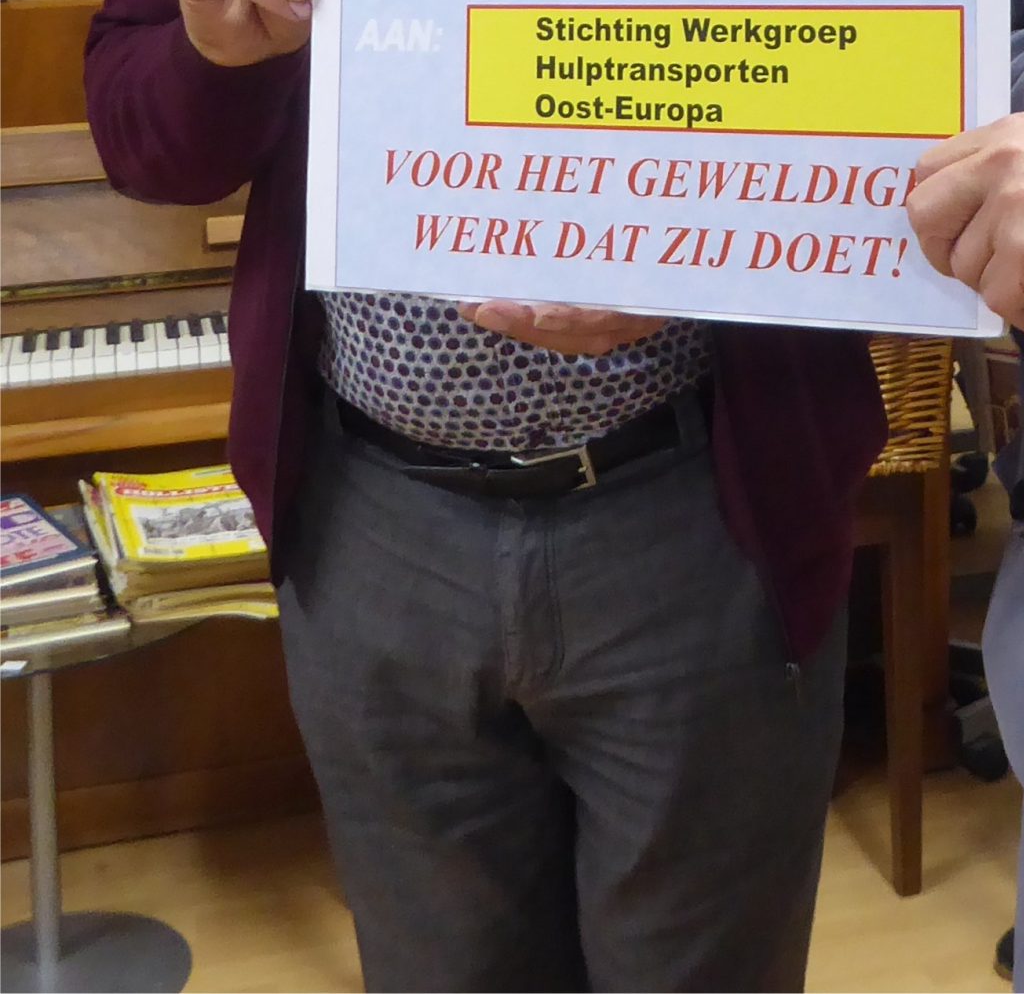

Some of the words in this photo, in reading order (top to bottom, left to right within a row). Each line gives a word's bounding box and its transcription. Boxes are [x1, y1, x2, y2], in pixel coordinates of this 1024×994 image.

[354, 18, 444, 53] AAN:
[535, 16, 672, 49] Stichting
[681, 17, 858, 51] Werkgroep
[535, 56, 790, 88] Hulptransporten
[534, 93, 724, 128] Oost-Europa
[385, 149, 504, 191] VOOR
[514, 154, 616, 195] HET
[414, 213, 545, 257] WERK
[552, 220, 650, 263] DAT
[657, 226, 738, 269] ZIJ
[745, 230, 909, 278] DOET!
